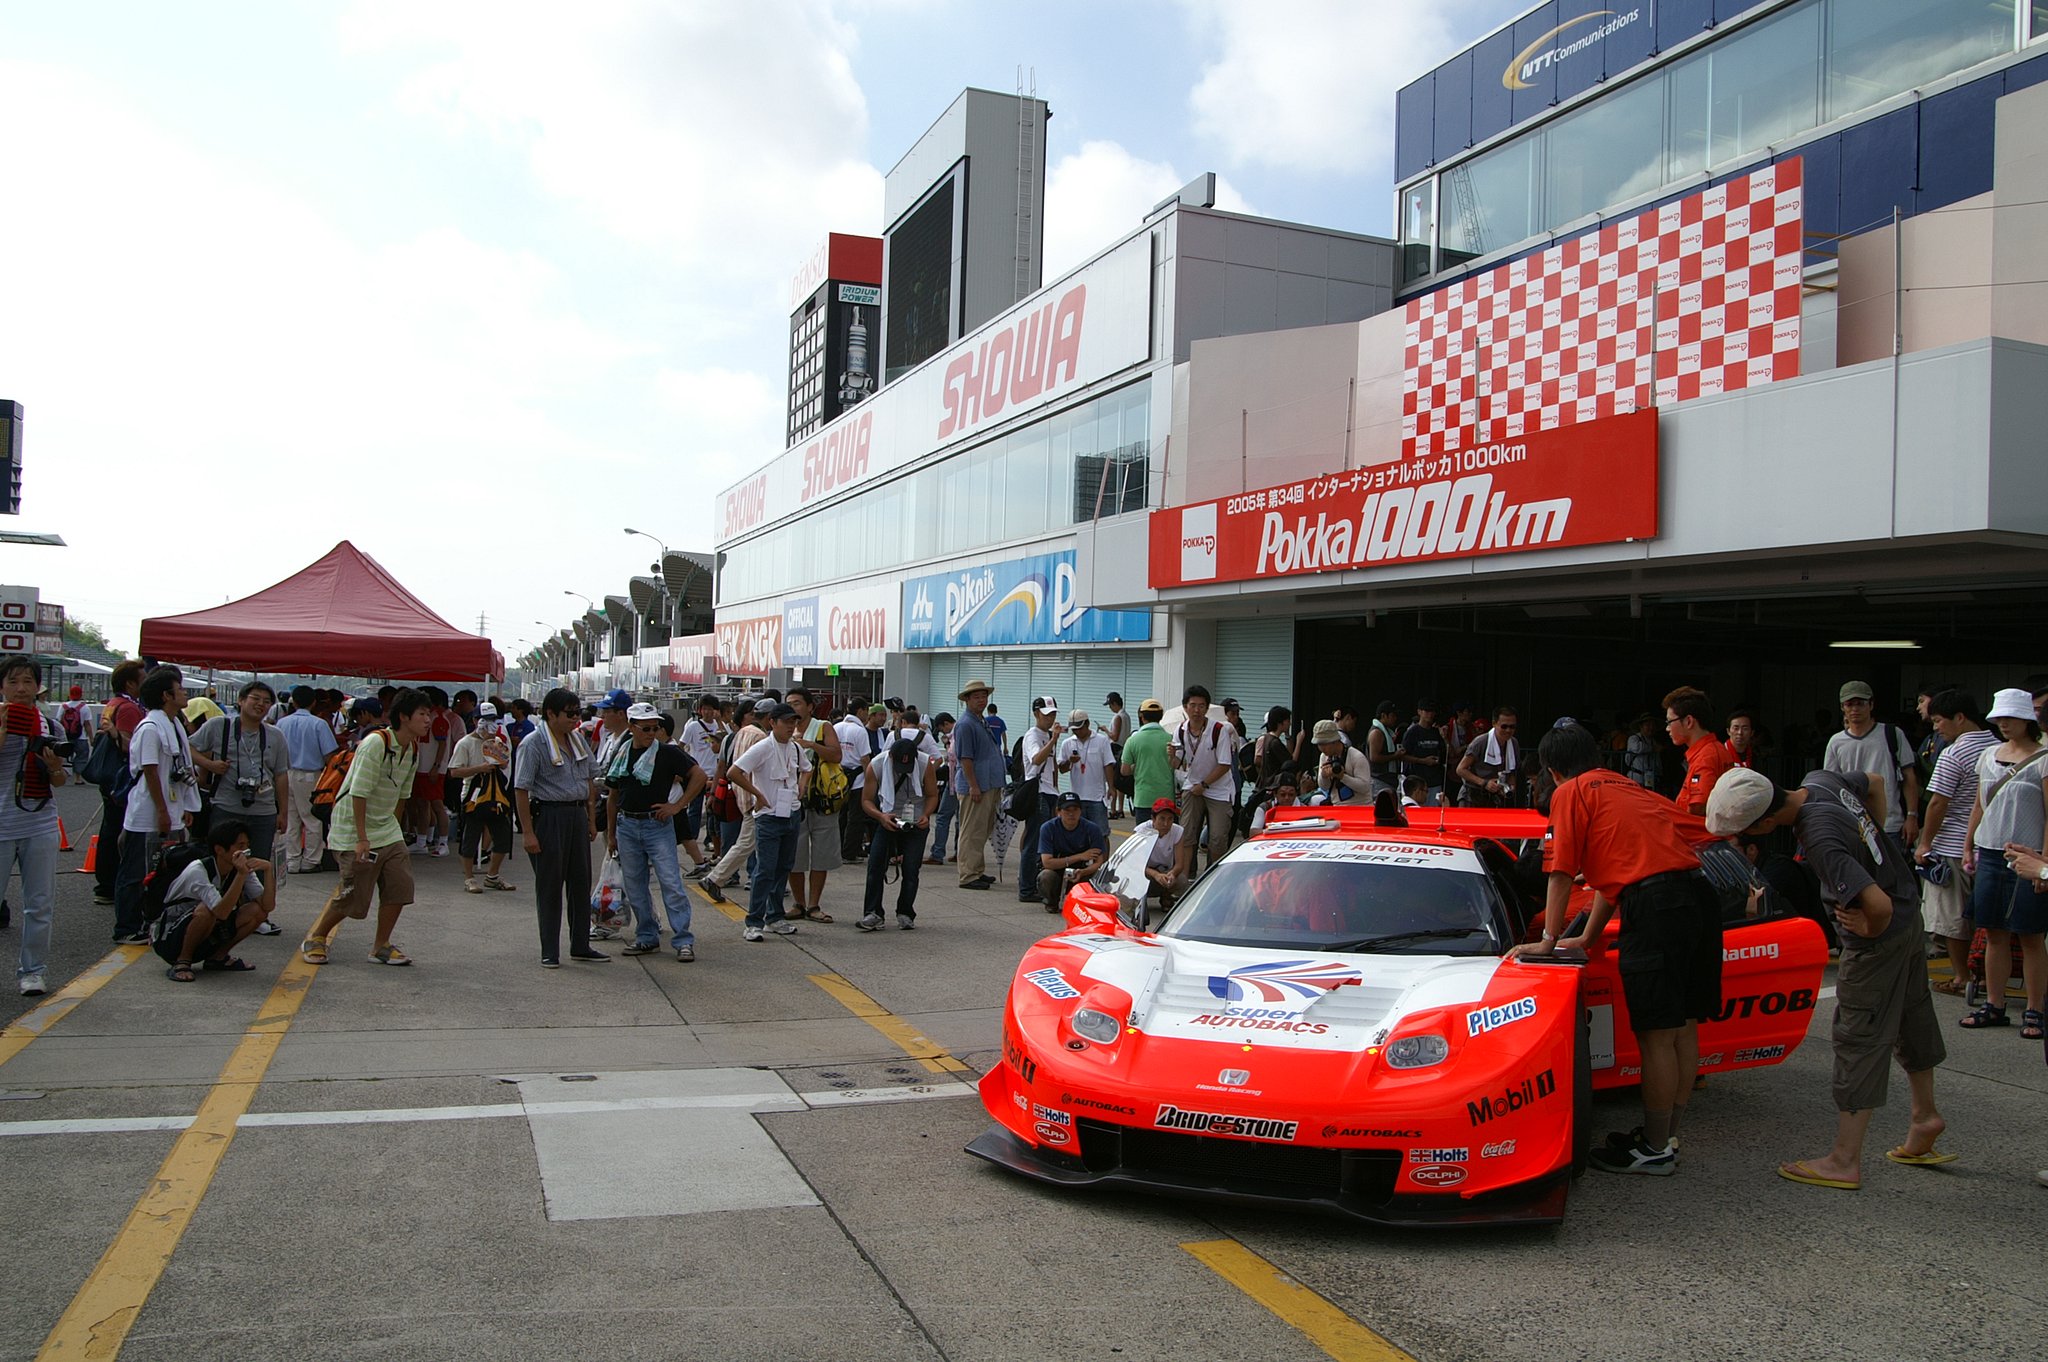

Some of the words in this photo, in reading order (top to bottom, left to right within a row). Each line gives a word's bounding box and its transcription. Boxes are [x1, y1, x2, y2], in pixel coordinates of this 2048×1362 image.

[1522, 48, 1554, 80] NTT
[1553, 8, 1639, 62] Communications
[840, 292, 874, 304] POWER
[842, 286, 878, 297] IRIDIUM
[938, 284, 1086, 440] SHOWA
[800, 410, 872, 504] SHOWA
[1226, 492, 1266, 516] 2005年
[1268, 484, 1304, 510] 第34回
[1308, 444, 1526, 500] インターナショナルポッカ1000km
[724, 474, 766, 537] SHOWA
[1183, 536, 1204, 549] POKKA
[1256, 510, 1352, 574] Pokka
[946, 568, 996, 642] Piknik
[788, 606, 814, 630] OFFICIAL
[828, 606, 886, 651] Canon
[748, 618, 779, 672] NGK
[788, 635, 812, 657] CAMERA
[1306, 852, 1390, 862] SUPER
[1352, 844, 1454, 856] AUTOBACS
[1027, 967, 1079, 1000] Plexus
[1189, 1014, 1330, 1034] AUTOBACS
[1226, 1007, 1302, 1020] super
[1468, 998, 1536, 1036] Plexus
[1753, 1046, 1784, 1060] Holts
[1196, 1083, 1228, 1092] Honda
[1228, 1086, 1262, 1096] Racing
[1466, 1081, 1534, 1128] Mobil
[1538, 1069, 1556, 1100] 1
[1044, 1108, 1070, 1124] Holts
[1073, 1098, 1136, 1115] AUTOBACS
[1037, 1126, 1065, 1140] DELPHI
[1156, 1106, 1297, 1140] BRIDGESTONE
[1340, 1126, 1423, 1138] AUTOBACS
[1433, 1148, 1468, 1162] Holts
[1417, 1170, 1460, 1180] DELPHI
